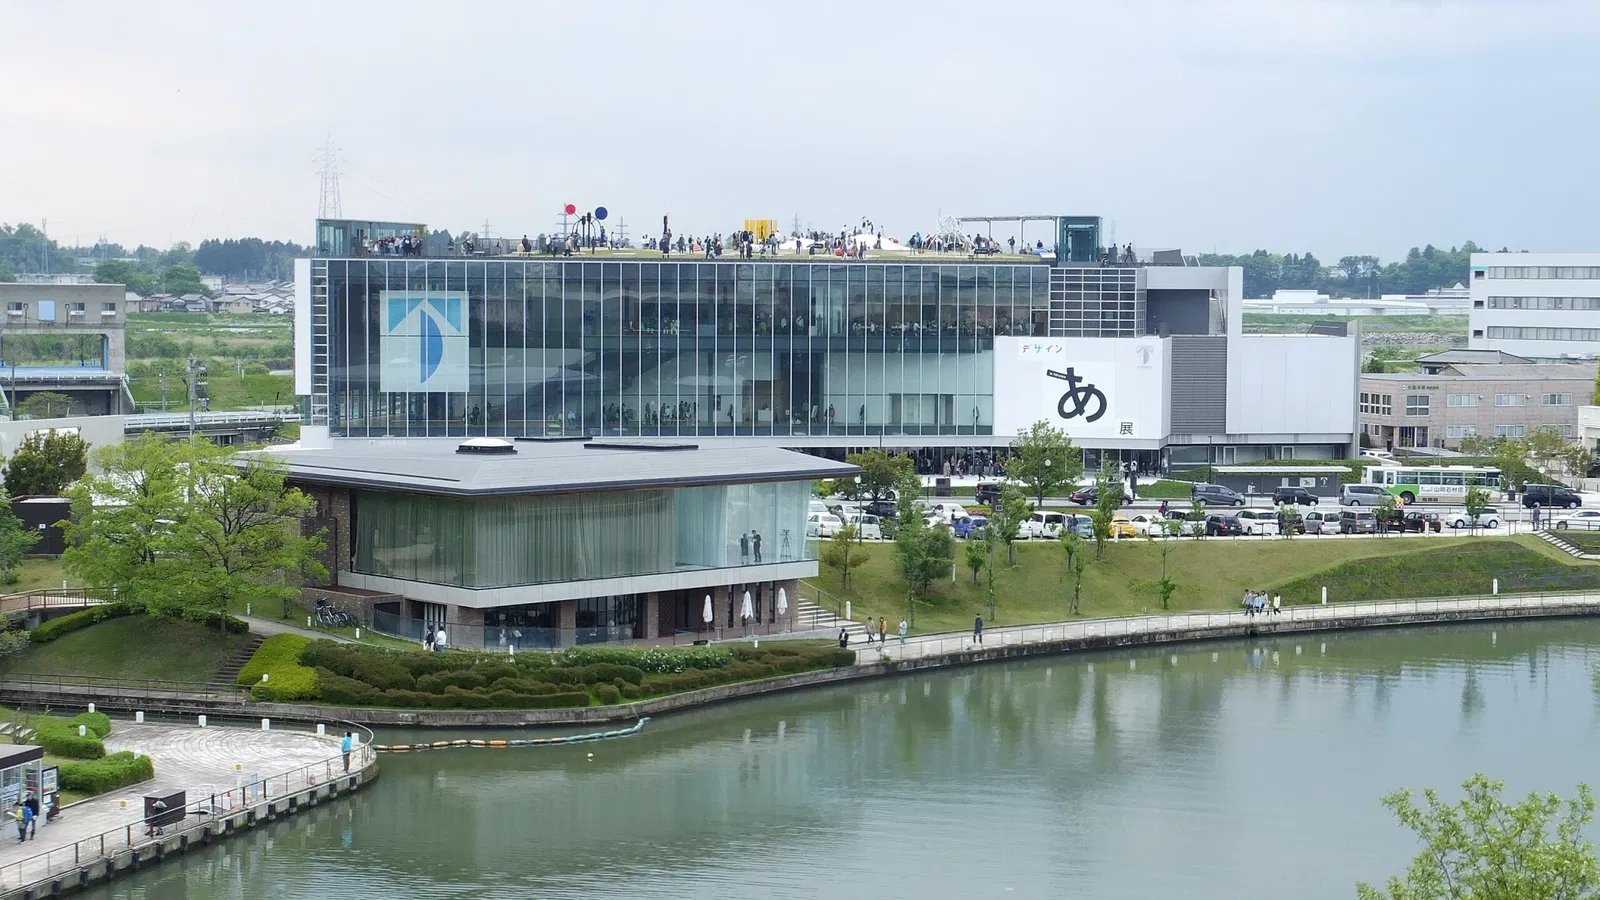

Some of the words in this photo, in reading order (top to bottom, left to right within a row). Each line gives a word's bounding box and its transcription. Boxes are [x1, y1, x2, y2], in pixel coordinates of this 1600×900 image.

[1022, 344, 1063, 354] デザイン
[1046, 367, 1107, 423] あ
[1119, 421, 1134, 436] 展
